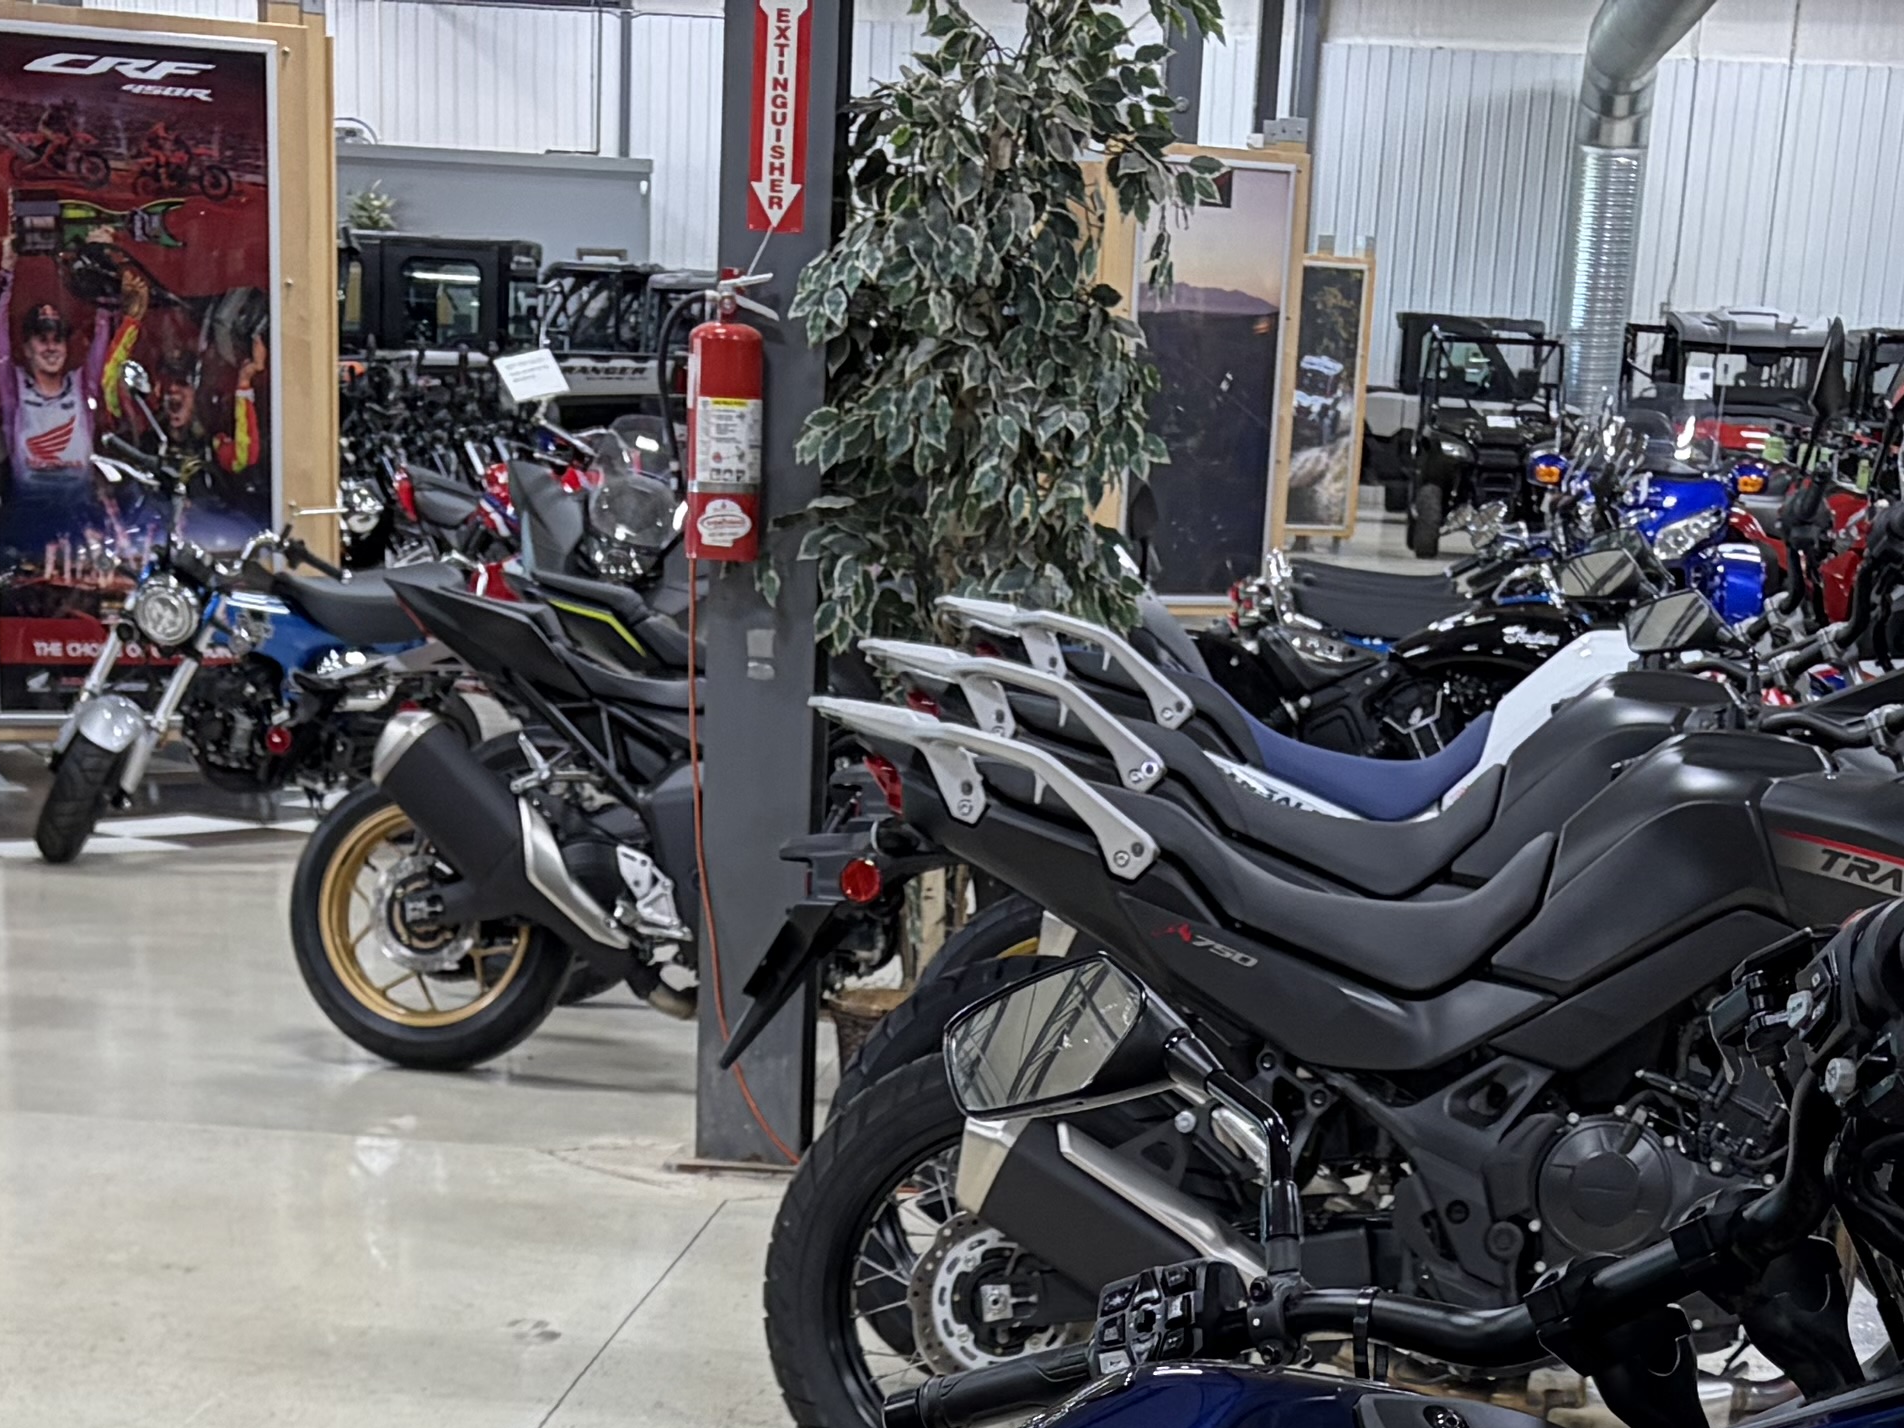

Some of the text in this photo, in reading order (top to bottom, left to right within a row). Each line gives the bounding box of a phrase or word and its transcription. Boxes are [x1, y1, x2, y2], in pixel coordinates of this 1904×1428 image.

[23, 52, 217, 81] CRF
[121, 83, 214, 102] 450R
[768, 8, 791, 211] EXTINGUISHER
[33, 641, 63, 657] THE
[1192, 935, 1258, 968] 750
